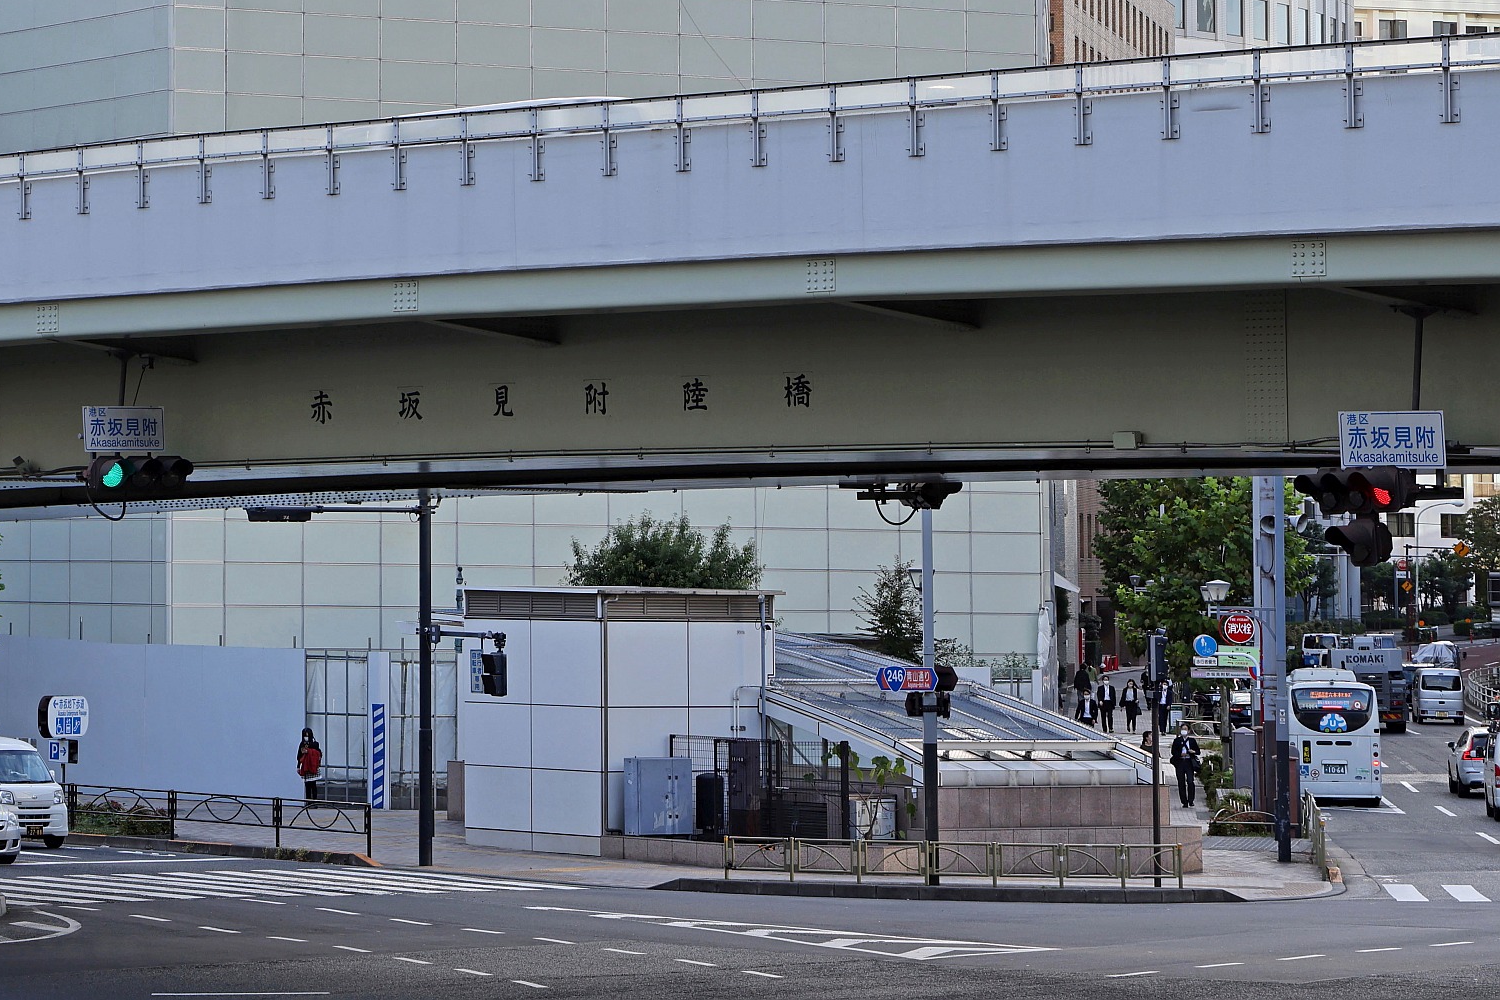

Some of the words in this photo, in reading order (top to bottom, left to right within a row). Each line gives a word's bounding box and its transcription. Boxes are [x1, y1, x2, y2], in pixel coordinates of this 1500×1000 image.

[309, 374, 814, 425] 赤坂見附陸橋
[88, 407, 106, 417] 港区
[1346, 413, 1369, 426] 港区
[90, 417, 157, 436] 赤坂見附
[90, 437, 160, 448] Akasakamitsuke
[1348, 426, 1436, 449] 赤坂見附
[1348, 450, 1439, 463] Akasakamitsuke
[1227, 622, 1252, 635] 消火栓
[886, 669, 904, 682] 246
[906, 671, 930, 682] 青山通り
[51, 743, 58, 759] P
